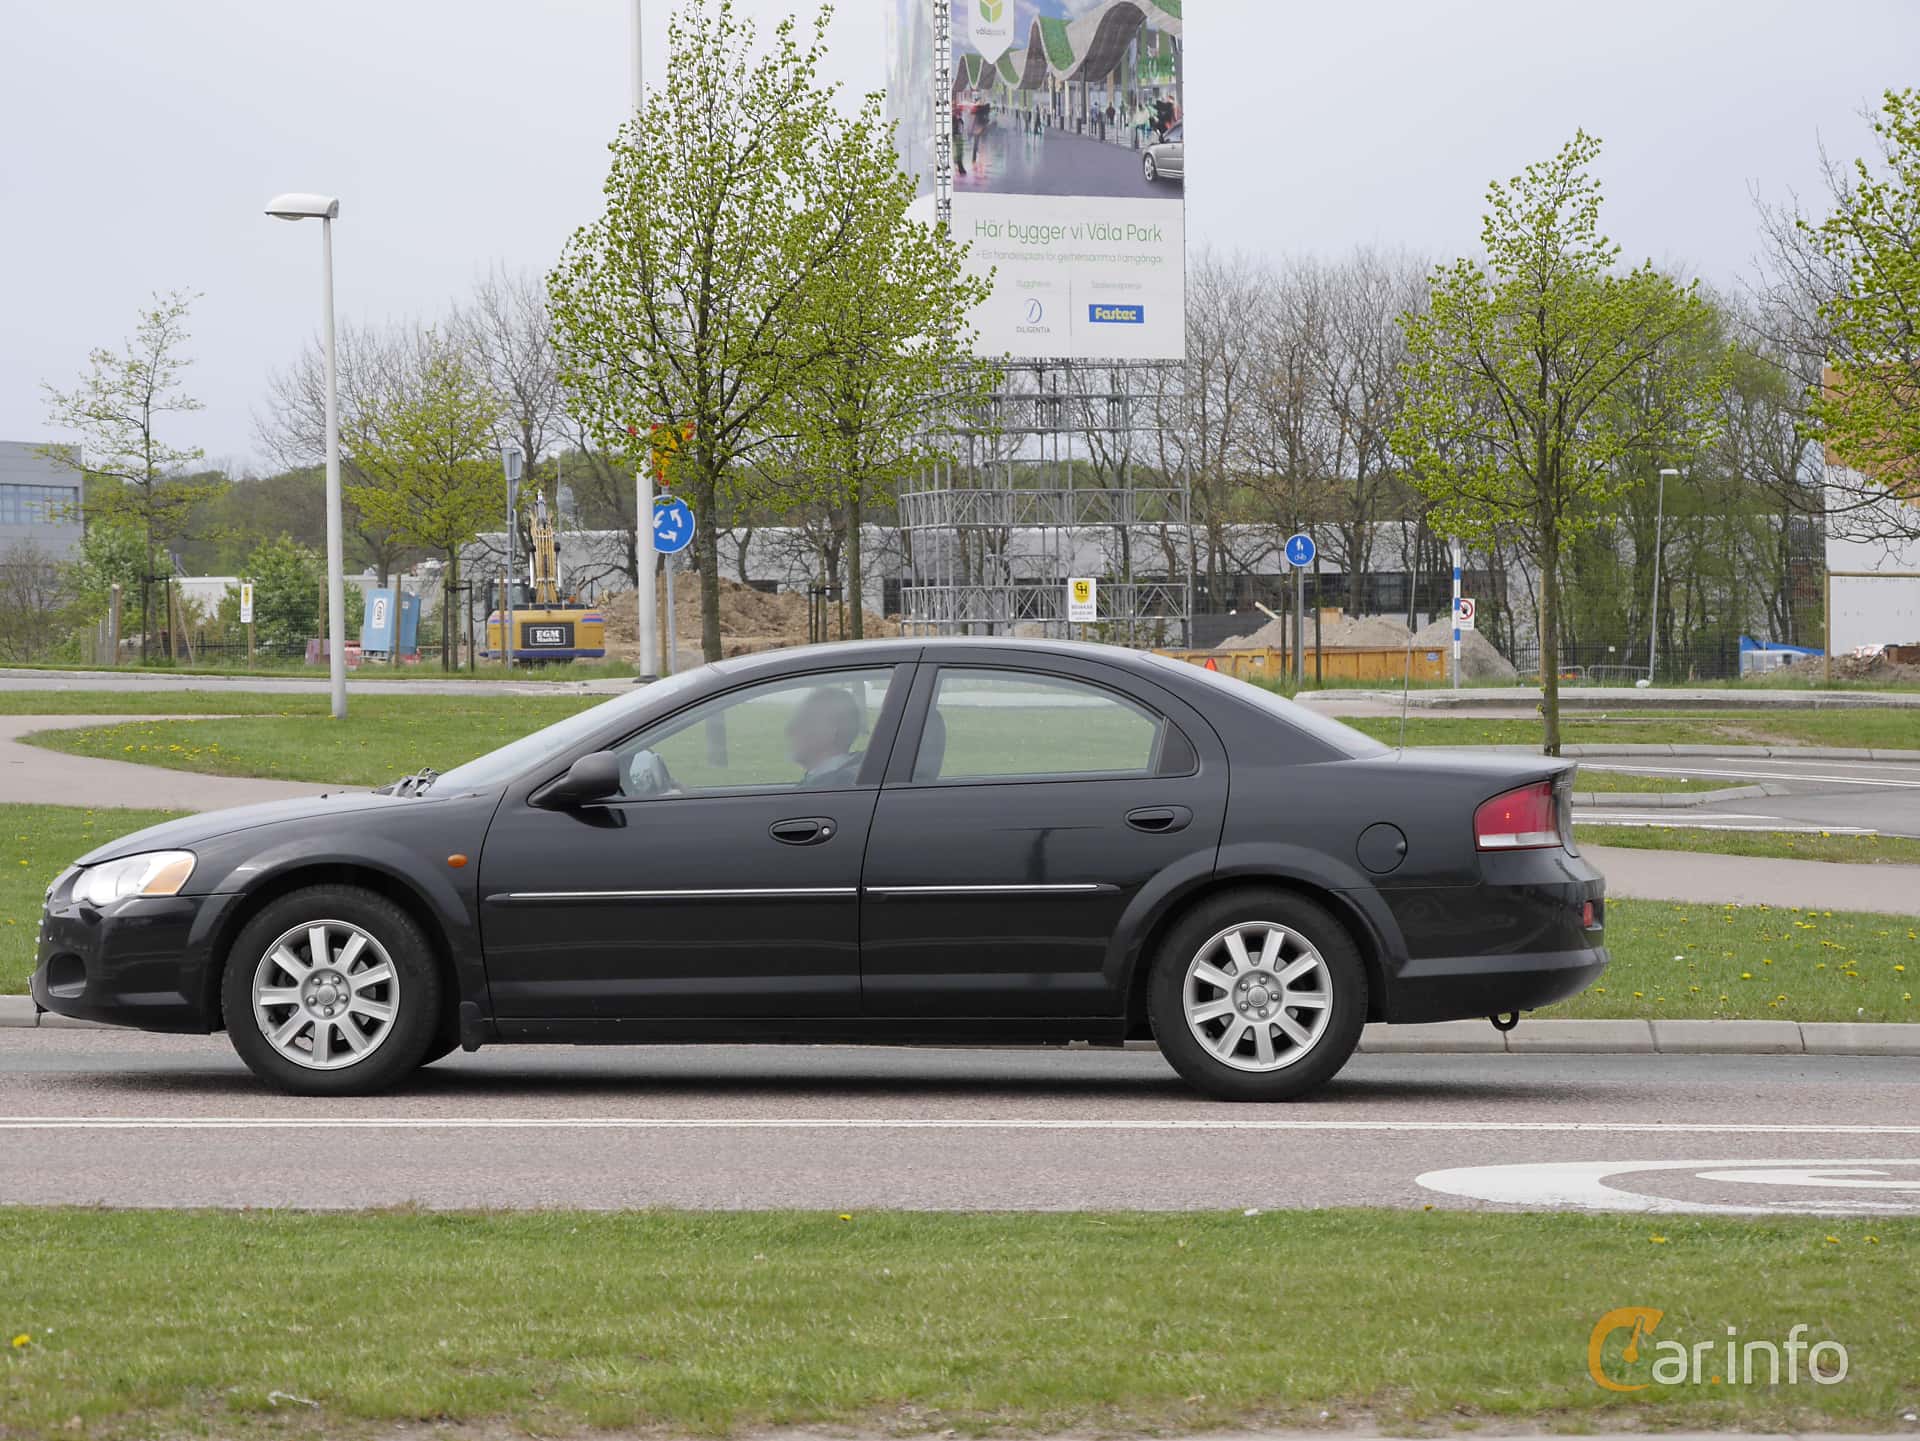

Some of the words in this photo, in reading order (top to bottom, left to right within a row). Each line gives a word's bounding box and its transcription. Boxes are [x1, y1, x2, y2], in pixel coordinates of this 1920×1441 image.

[975, 219, 1003, 238] Här
[1008, 220, 1066, 245] bygger
[1070, 223, 1083, 240] vi
[1087, 222, 1122, 241] Väla
[1127, 224, 1163, 242] Park
[1094, 307, 1137, 320] Fastec
